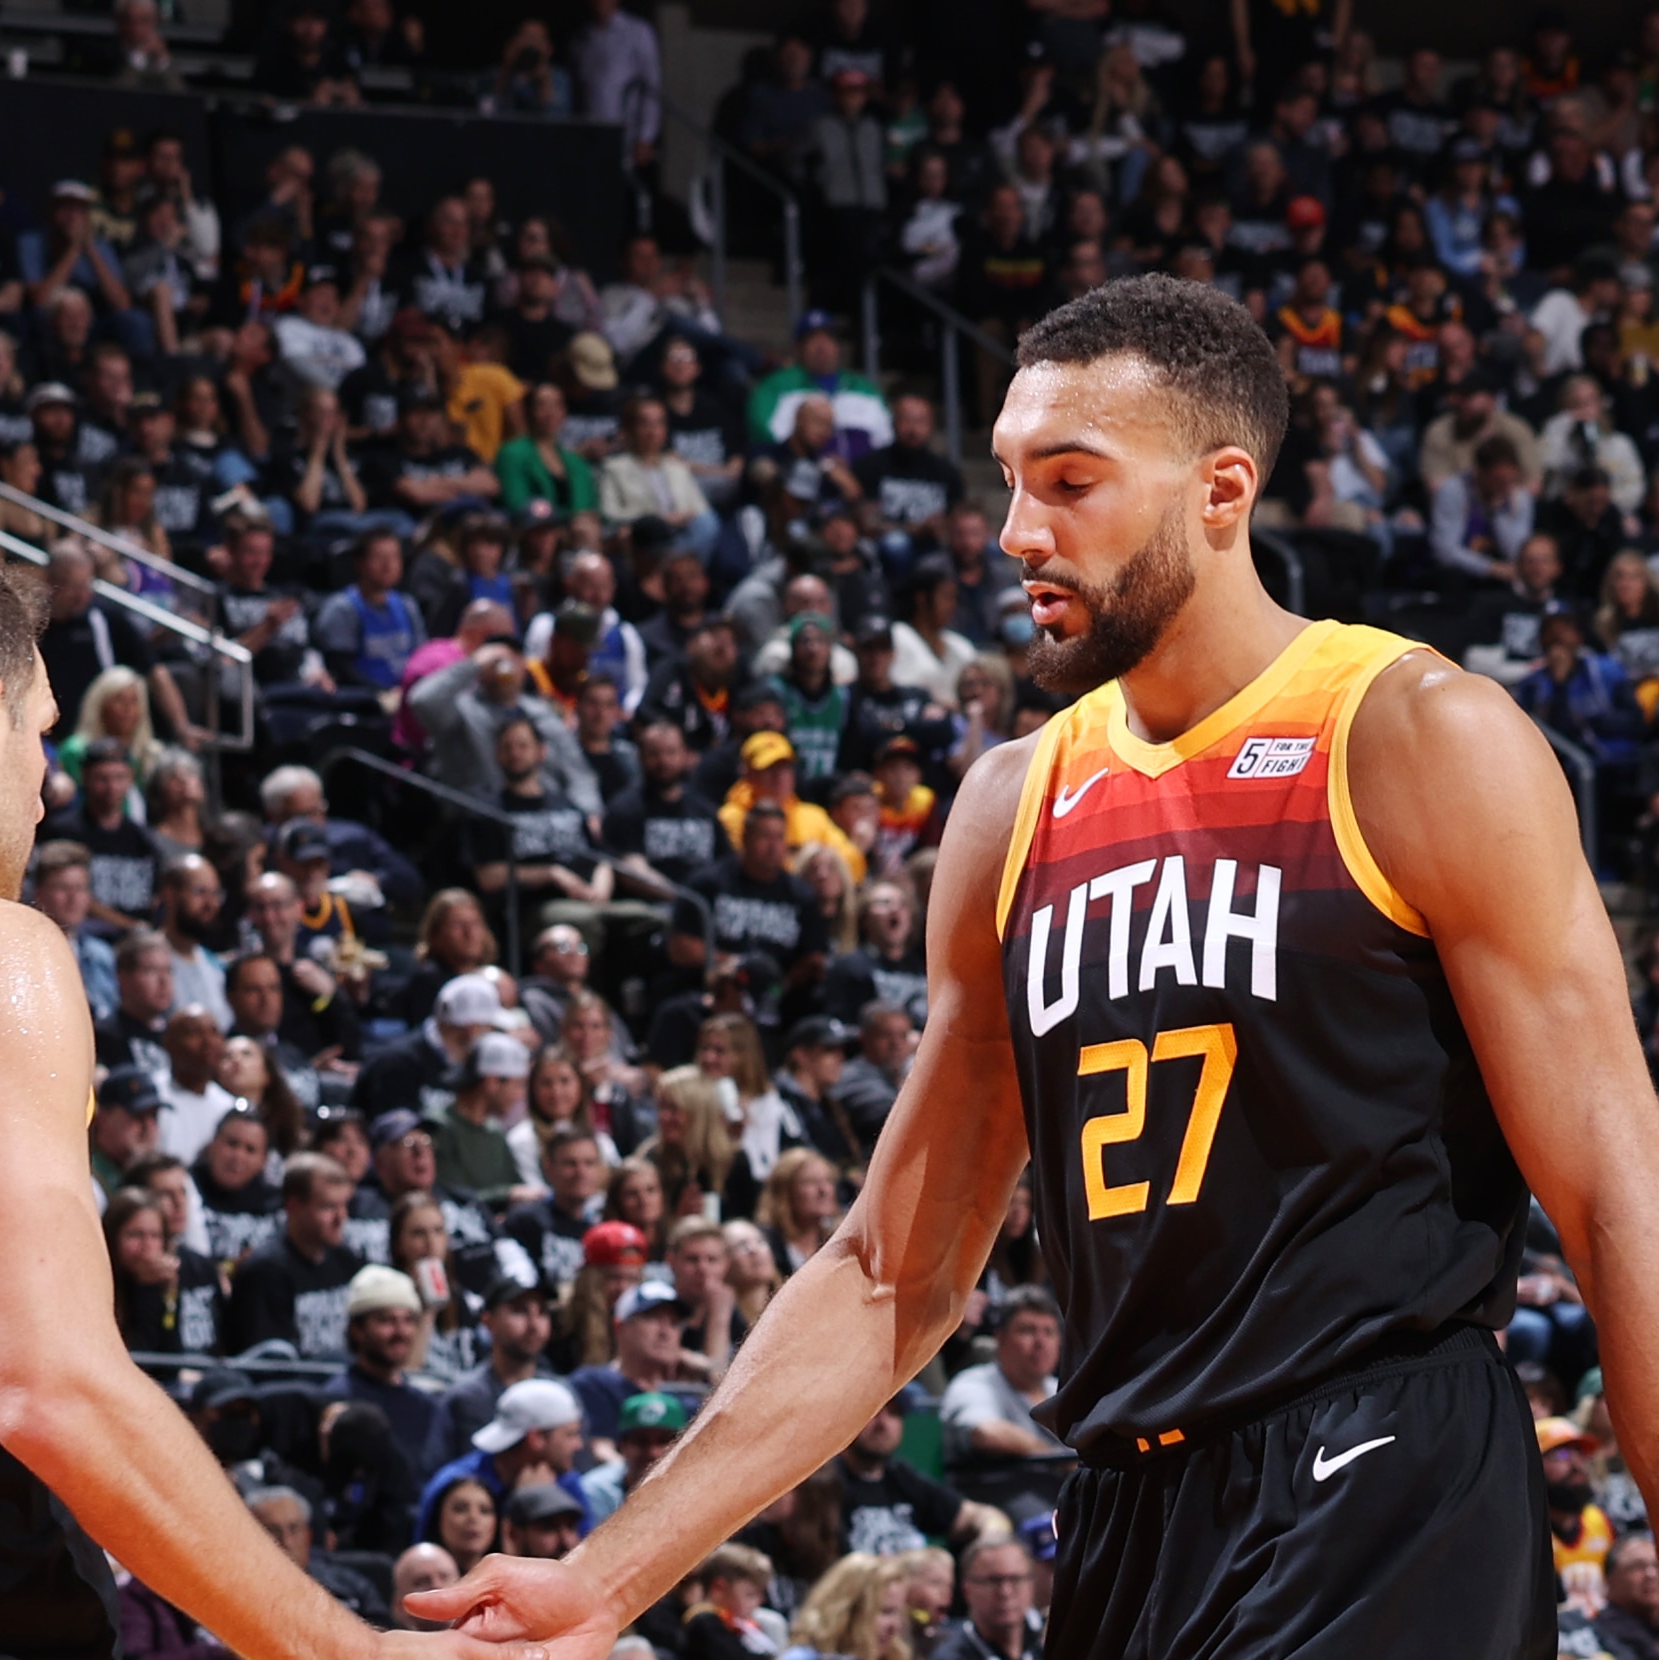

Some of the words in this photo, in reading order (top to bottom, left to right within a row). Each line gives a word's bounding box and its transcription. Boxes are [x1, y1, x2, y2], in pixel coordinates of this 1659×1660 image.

[1236, 743, 1266, 775] 5
[1274, 743, 1293, 752] FOR
[1260, 756, 1307, 774] FIGHT
[1027, 855, 1282, 1038] UTAH
[1077, 1022, 1238, 1221] 27
